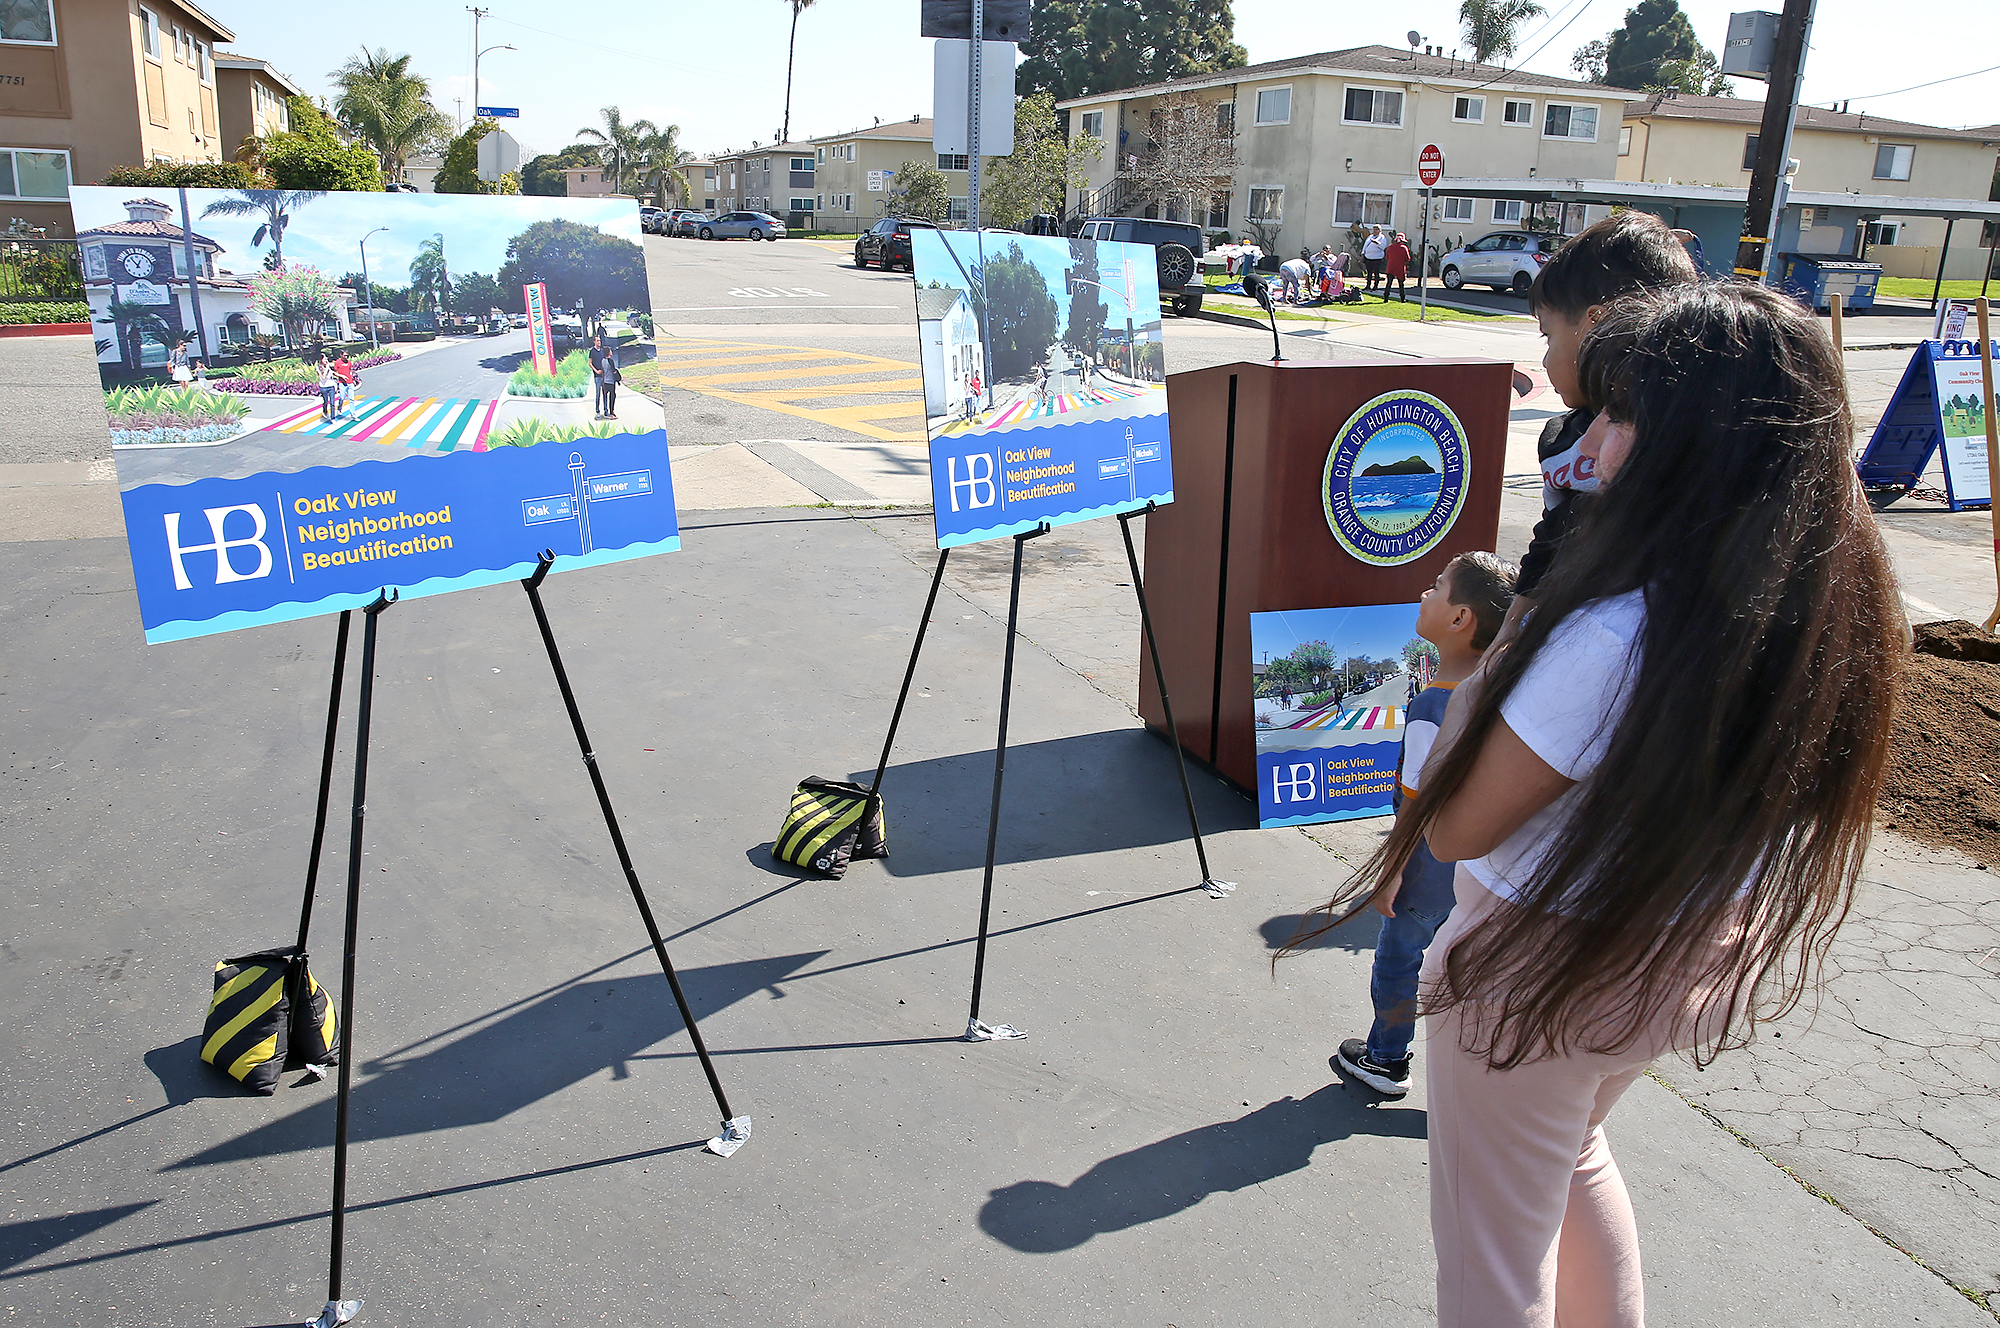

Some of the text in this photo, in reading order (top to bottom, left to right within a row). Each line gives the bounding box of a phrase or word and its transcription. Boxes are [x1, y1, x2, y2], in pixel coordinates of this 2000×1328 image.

[478, 108, 492, 116] Oak
[1422, 152, 1440, 160] DO NOT
[726, 286, 831, 298] STOP
[529, 287, 546, 355] OAK VIEW
[1334, 404, 1459, 478] CITY OF HUNTINGTON BEACH
[1378, 428, 1425, 443] INCORPORATED
[1004, 446, 1051, 464] Oak View
[1136, 448, 1153, 458] Nichols
[1006, 461, 1075, 485] Neighborhood
[1100, 464, 1119, 473] Warner
[593, 482, 628, 494] Warner
[947, 452, 996, 512] HB
[1007, 480, 1075, 503] Beautification
[294, 488, 397, 516] Oak View
[527, 504, 550, 517] Oak
[297, 505, 452, 544] Neighborhood
[1333, 486, 1458, 553] ORANGE COUNTY CALIFORNIA
[1368, 516, 1380, 527] FEB.
[163, 502, 273, 591] HB
[302, 533, 454, 571] Beautification
[1327, 757, 1375, 770] Oak View
[1272, 762, 1316, 804] HB
[1329, 781, 1394, 798] Beautificatio
